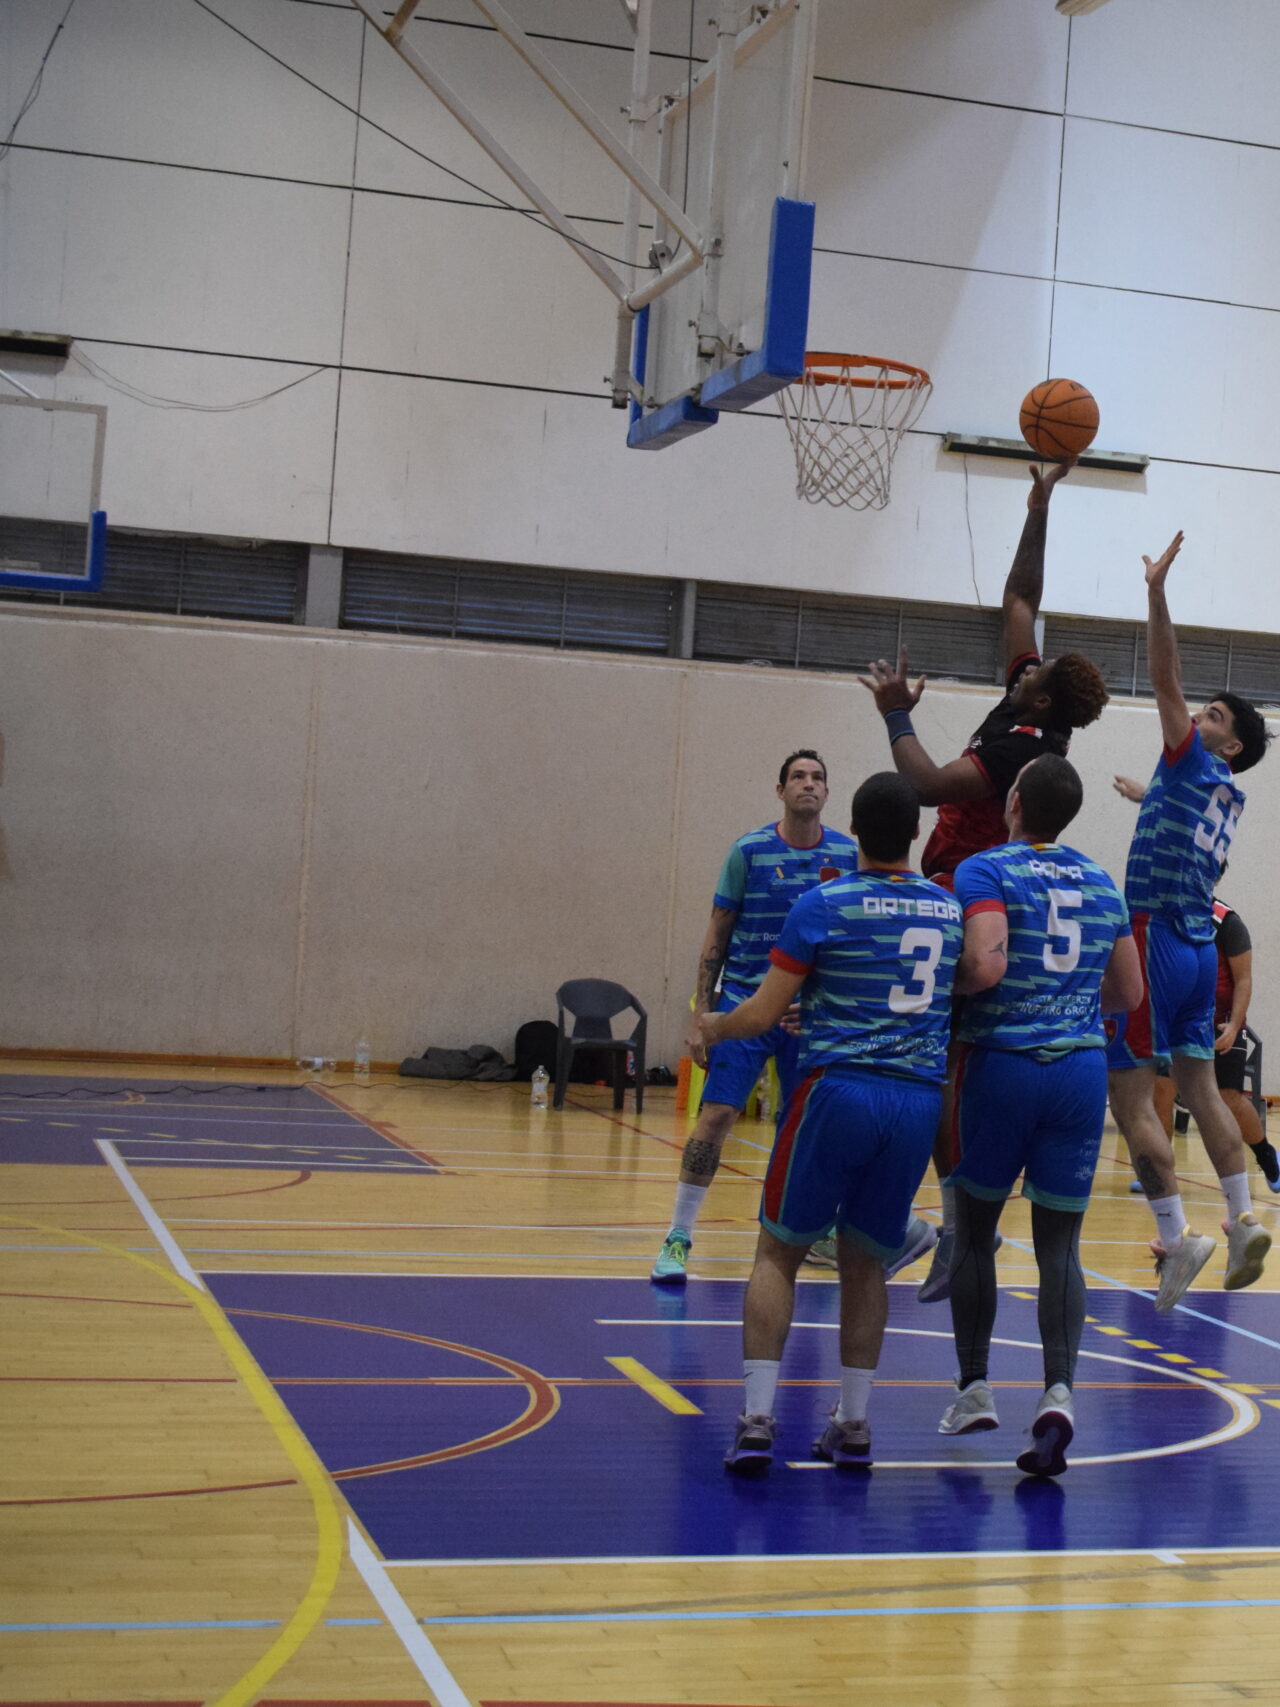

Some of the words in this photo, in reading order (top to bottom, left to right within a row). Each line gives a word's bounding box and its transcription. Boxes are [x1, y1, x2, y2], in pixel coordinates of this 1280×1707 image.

[863, 896, 961, 922] ORTEGA
[1043, 888, 1083, 973] 5
[888, 927, 944, 1014] 3
